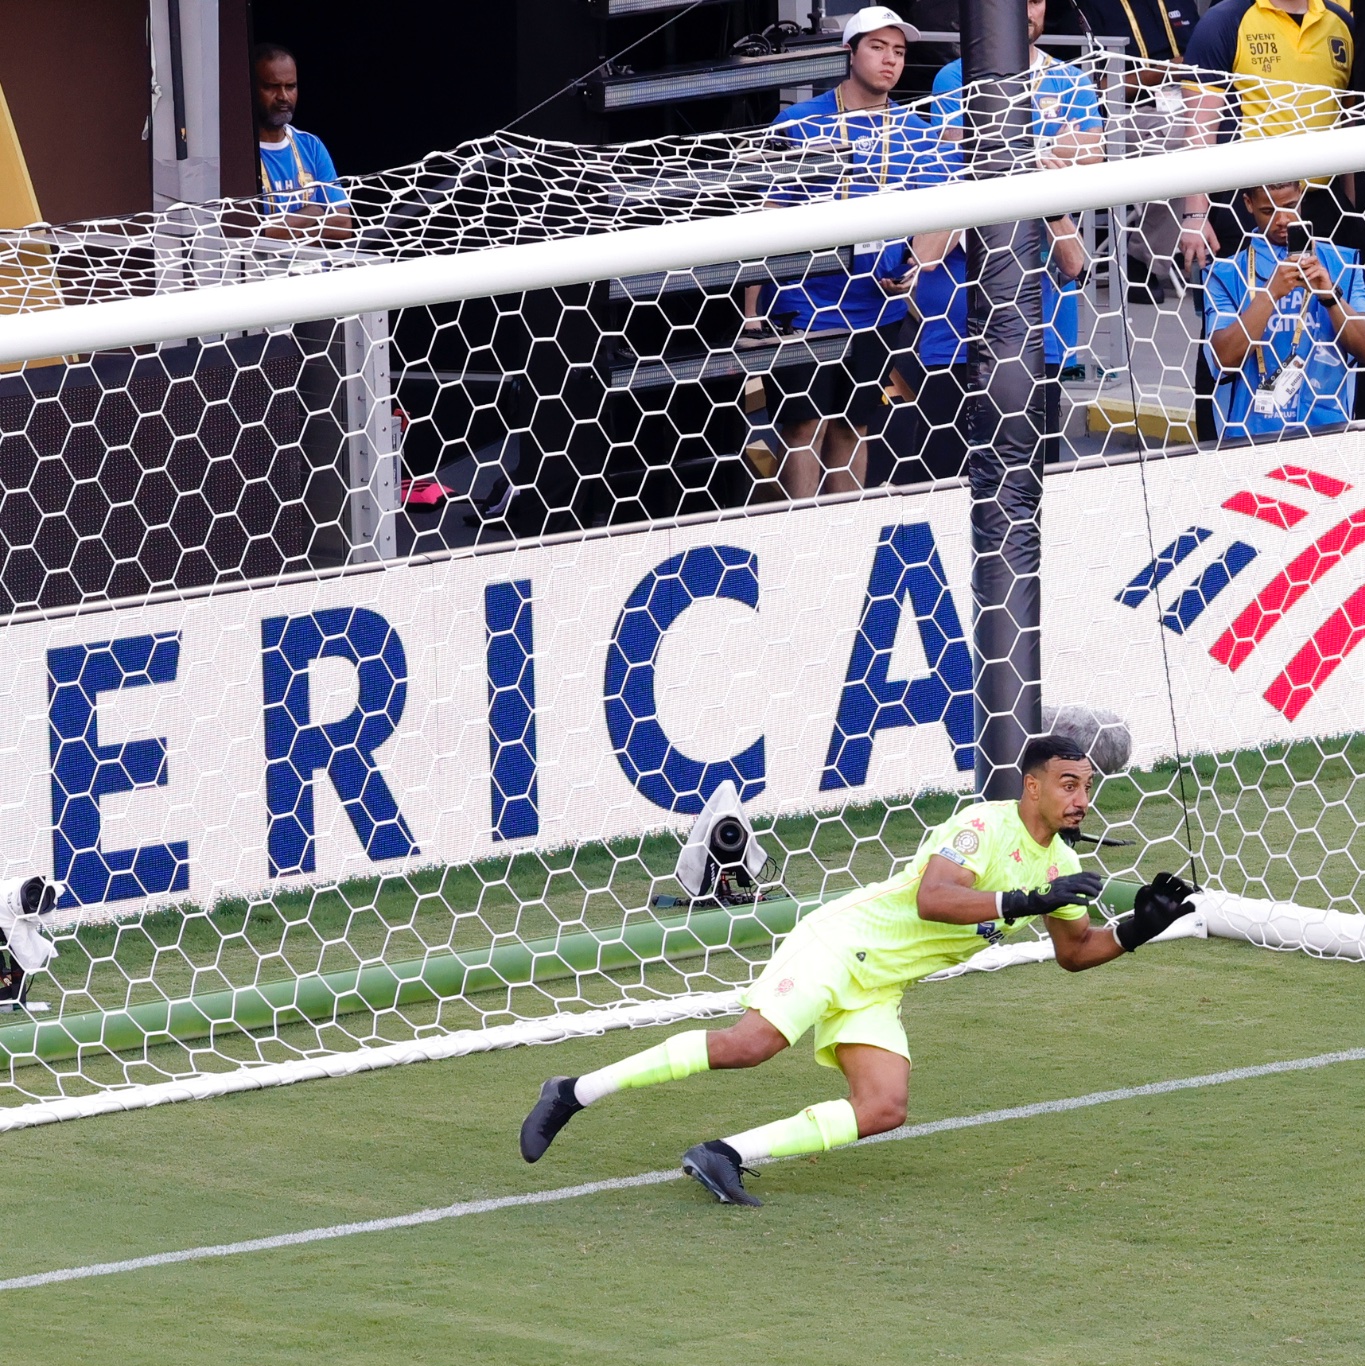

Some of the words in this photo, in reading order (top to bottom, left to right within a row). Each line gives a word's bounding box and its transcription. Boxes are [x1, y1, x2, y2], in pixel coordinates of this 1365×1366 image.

[1246, 33, 1275, 42] EVENT
[1249, 42, 1278, 55] 5078
[1251, 55, 1282, 65] STAFF
